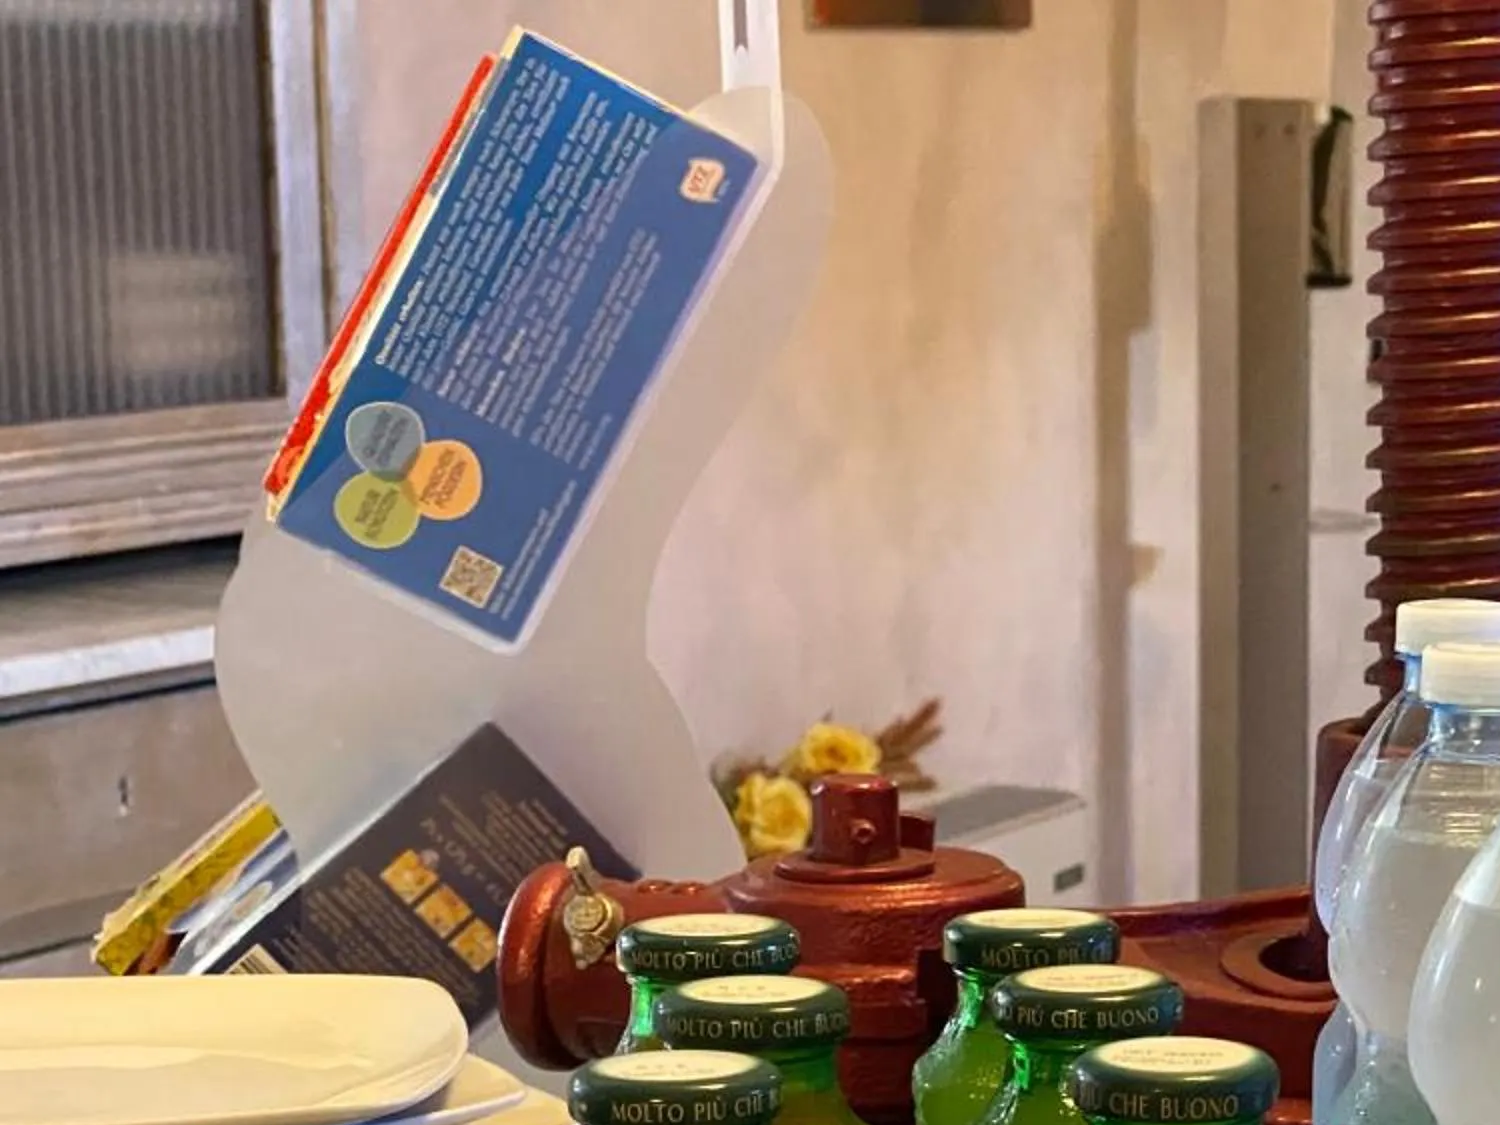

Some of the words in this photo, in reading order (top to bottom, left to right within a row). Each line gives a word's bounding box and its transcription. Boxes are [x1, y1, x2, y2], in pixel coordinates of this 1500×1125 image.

[631, 950, 686, 966] MOLTO
[667, 1016, 722, 1039] MOLTO
[1051, 1011, 1087, 1029] CHE
[1097, 1007, 1160, 1028] BUONO
[611, 1101, 685, 1123] MOLTO
[694, 1096, 727, 1121] PIÙ
[1109, 1092, 1149, 1119] CHE
[1160, 1094, 1239, 1120] BUONO
